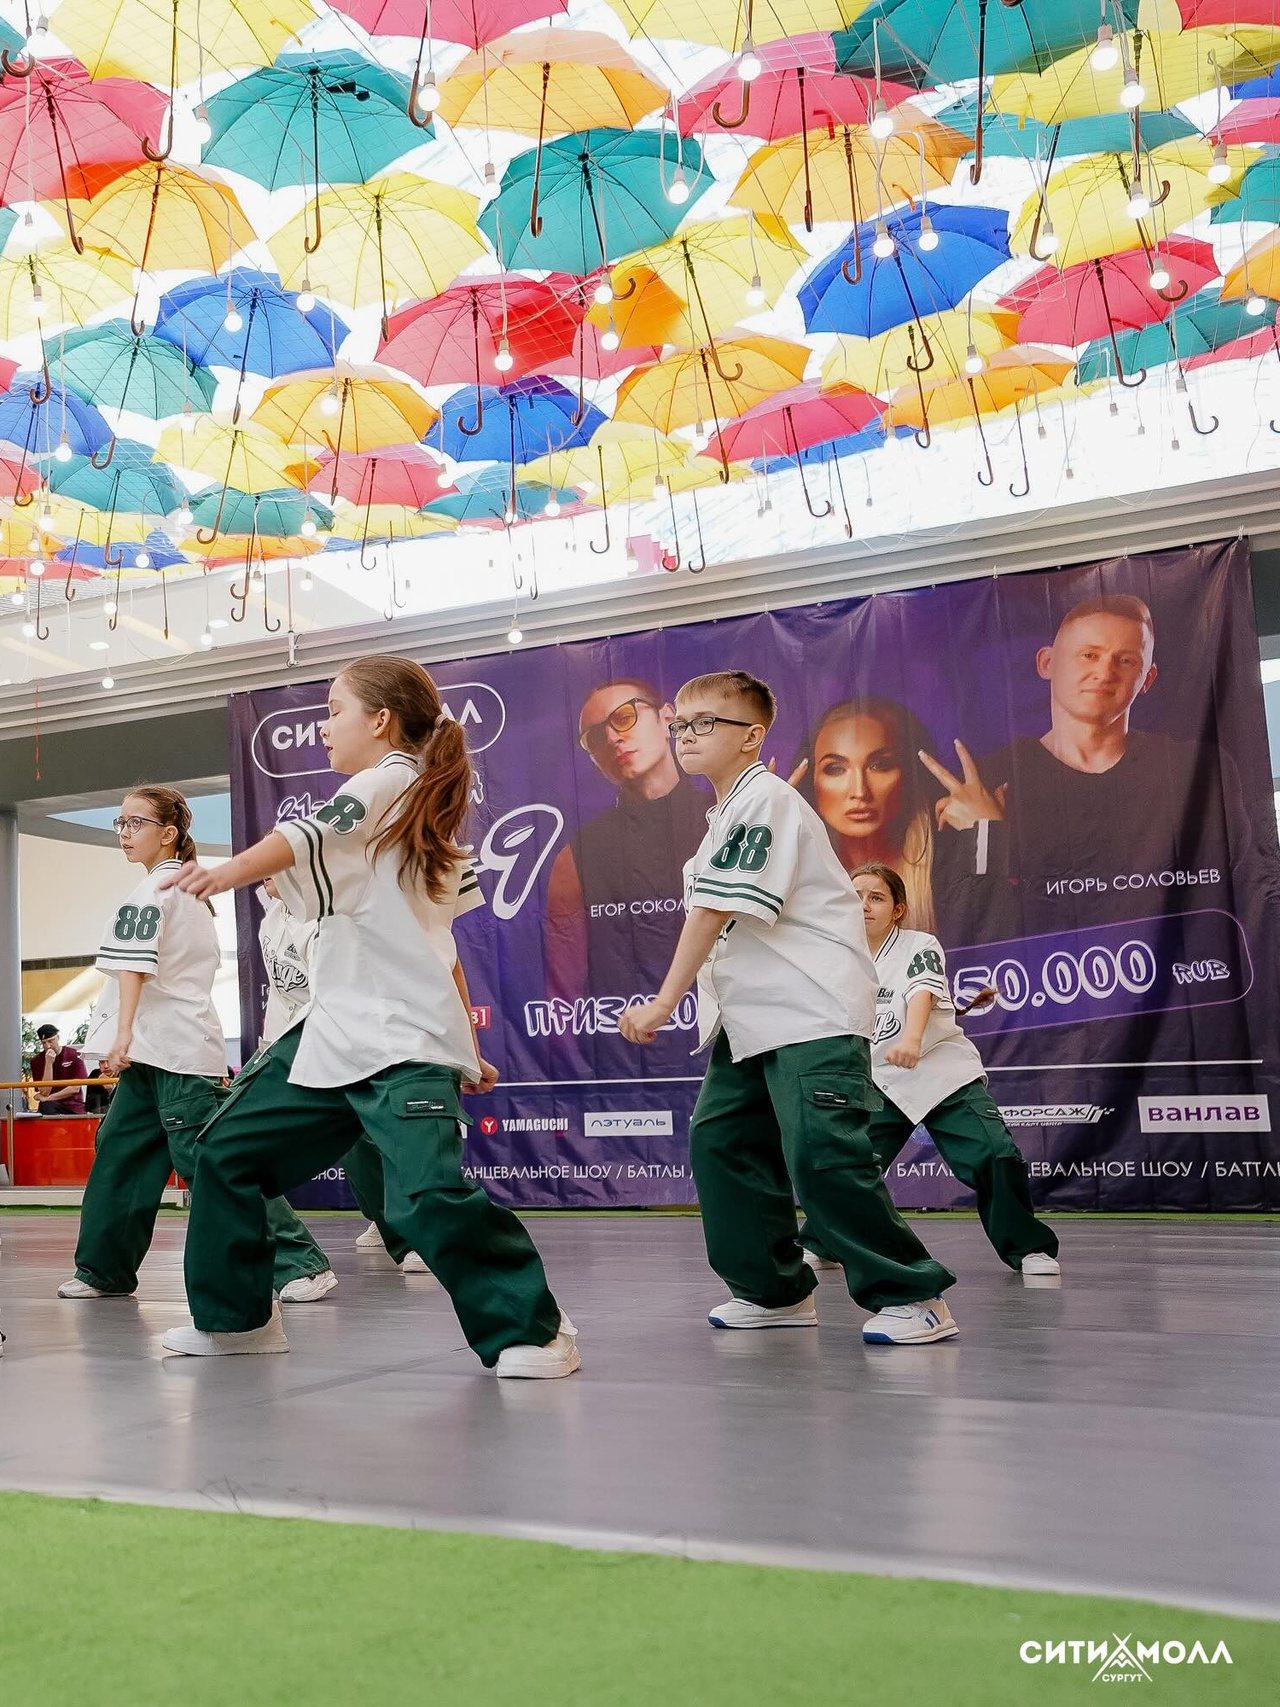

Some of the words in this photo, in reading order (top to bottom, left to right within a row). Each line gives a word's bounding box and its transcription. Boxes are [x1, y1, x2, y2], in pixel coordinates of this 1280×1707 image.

[709, 822, 774, 874] 88
[1046, 876, 1108, 896] ИГОРЬ
[1113, 868, 1221, 891] СОЛОВЬЕВ
[590, 903, 625, 918] ЕГОР
[629, 899, 686, 914] СОКОЛ
[114, 904, 162, 942] 88
[1172, 959, 1231, 985] RUB
[524, 991, 698, 1038] ПРИЗО
[1003, 1107, 1086, 1117] ФОРСАЖ
[502, 1118, 569, 1132] YAMAGUCHI
[461, 1165, 569, 1181] АНЦЕВАЛЬНОЕ
[573, 1165, 611, 1179] ШОУ
[627, 1165, 685, 1179] БАТТЛЫ
[1028, 1161, 1136, 1179] ЕВАЛЬНОЕ
[1141, 1161, 1193, 1177] ШОУ
